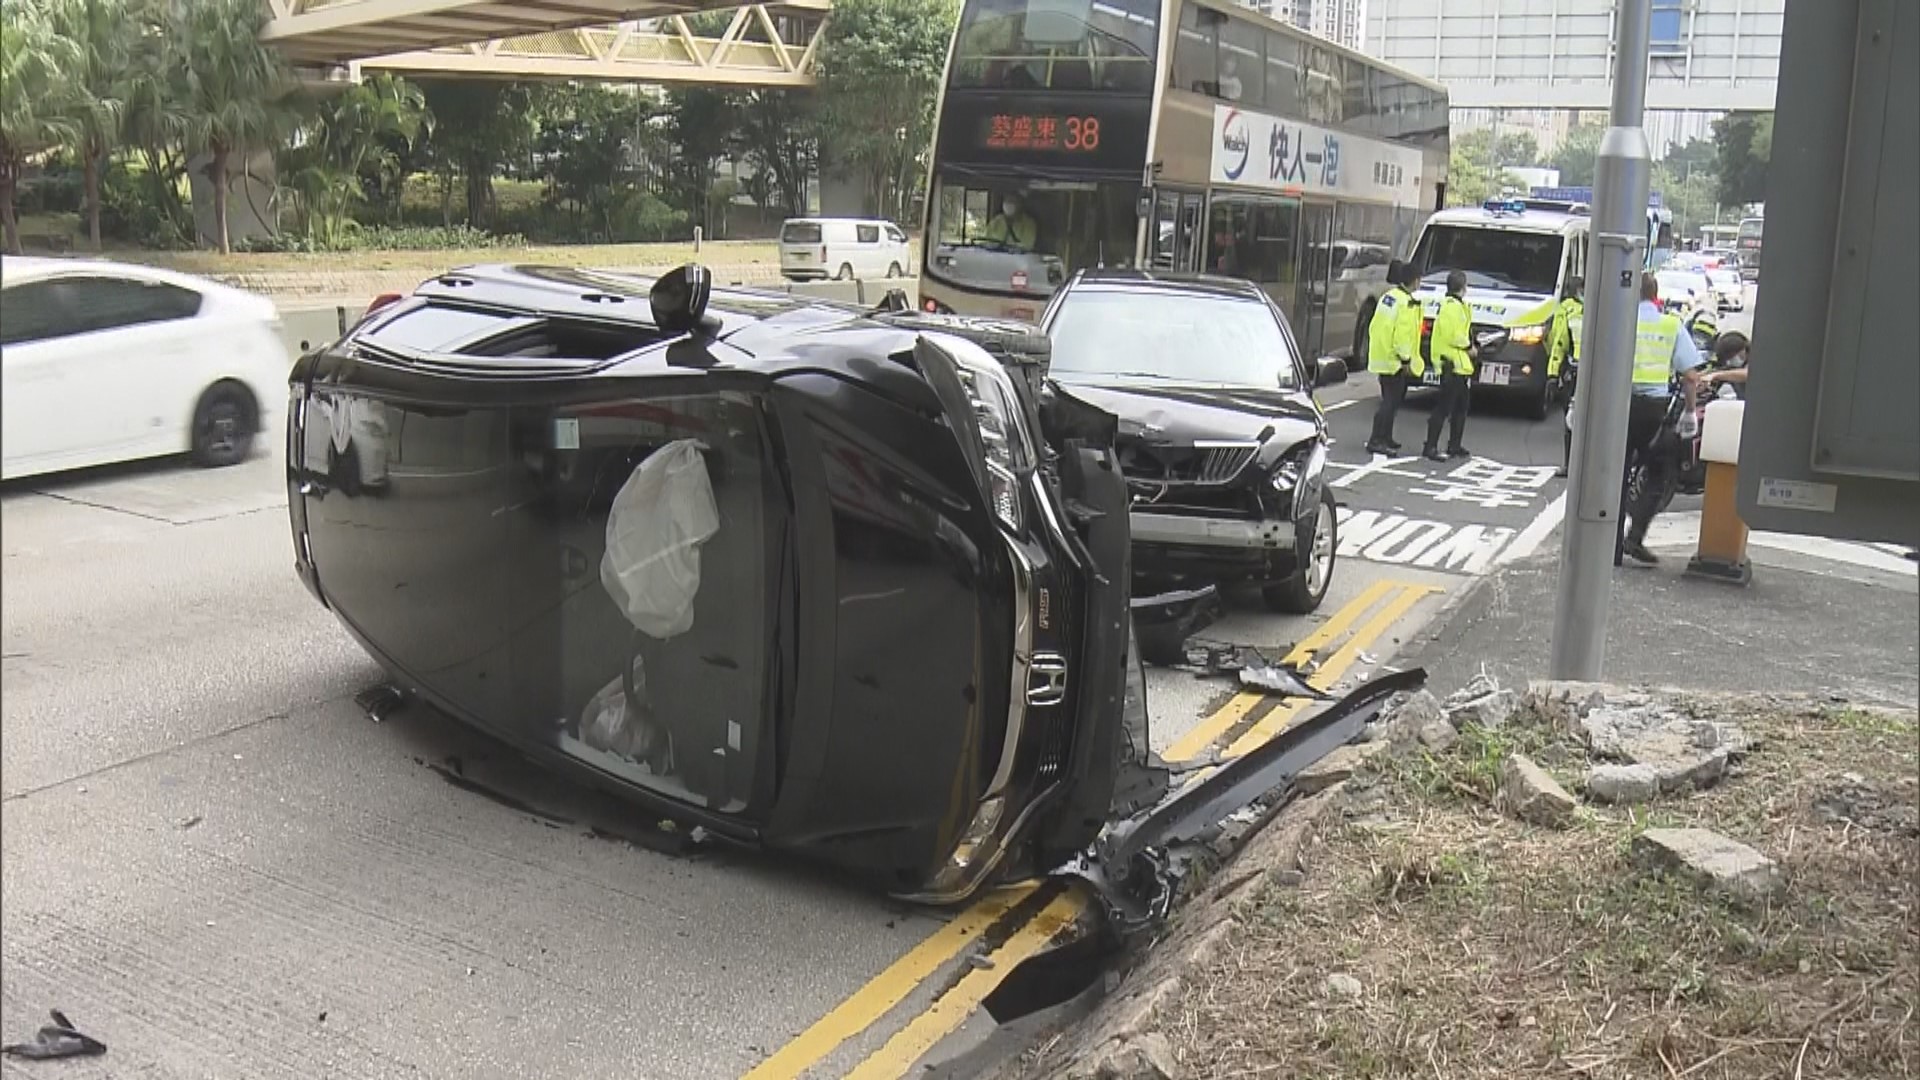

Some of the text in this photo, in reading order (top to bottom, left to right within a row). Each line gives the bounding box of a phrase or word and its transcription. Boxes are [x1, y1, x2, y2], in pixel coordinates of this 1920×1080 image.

[1064, 116, 1099, 149] 38
[1268, 122, 1340, 187] 快人一泡
